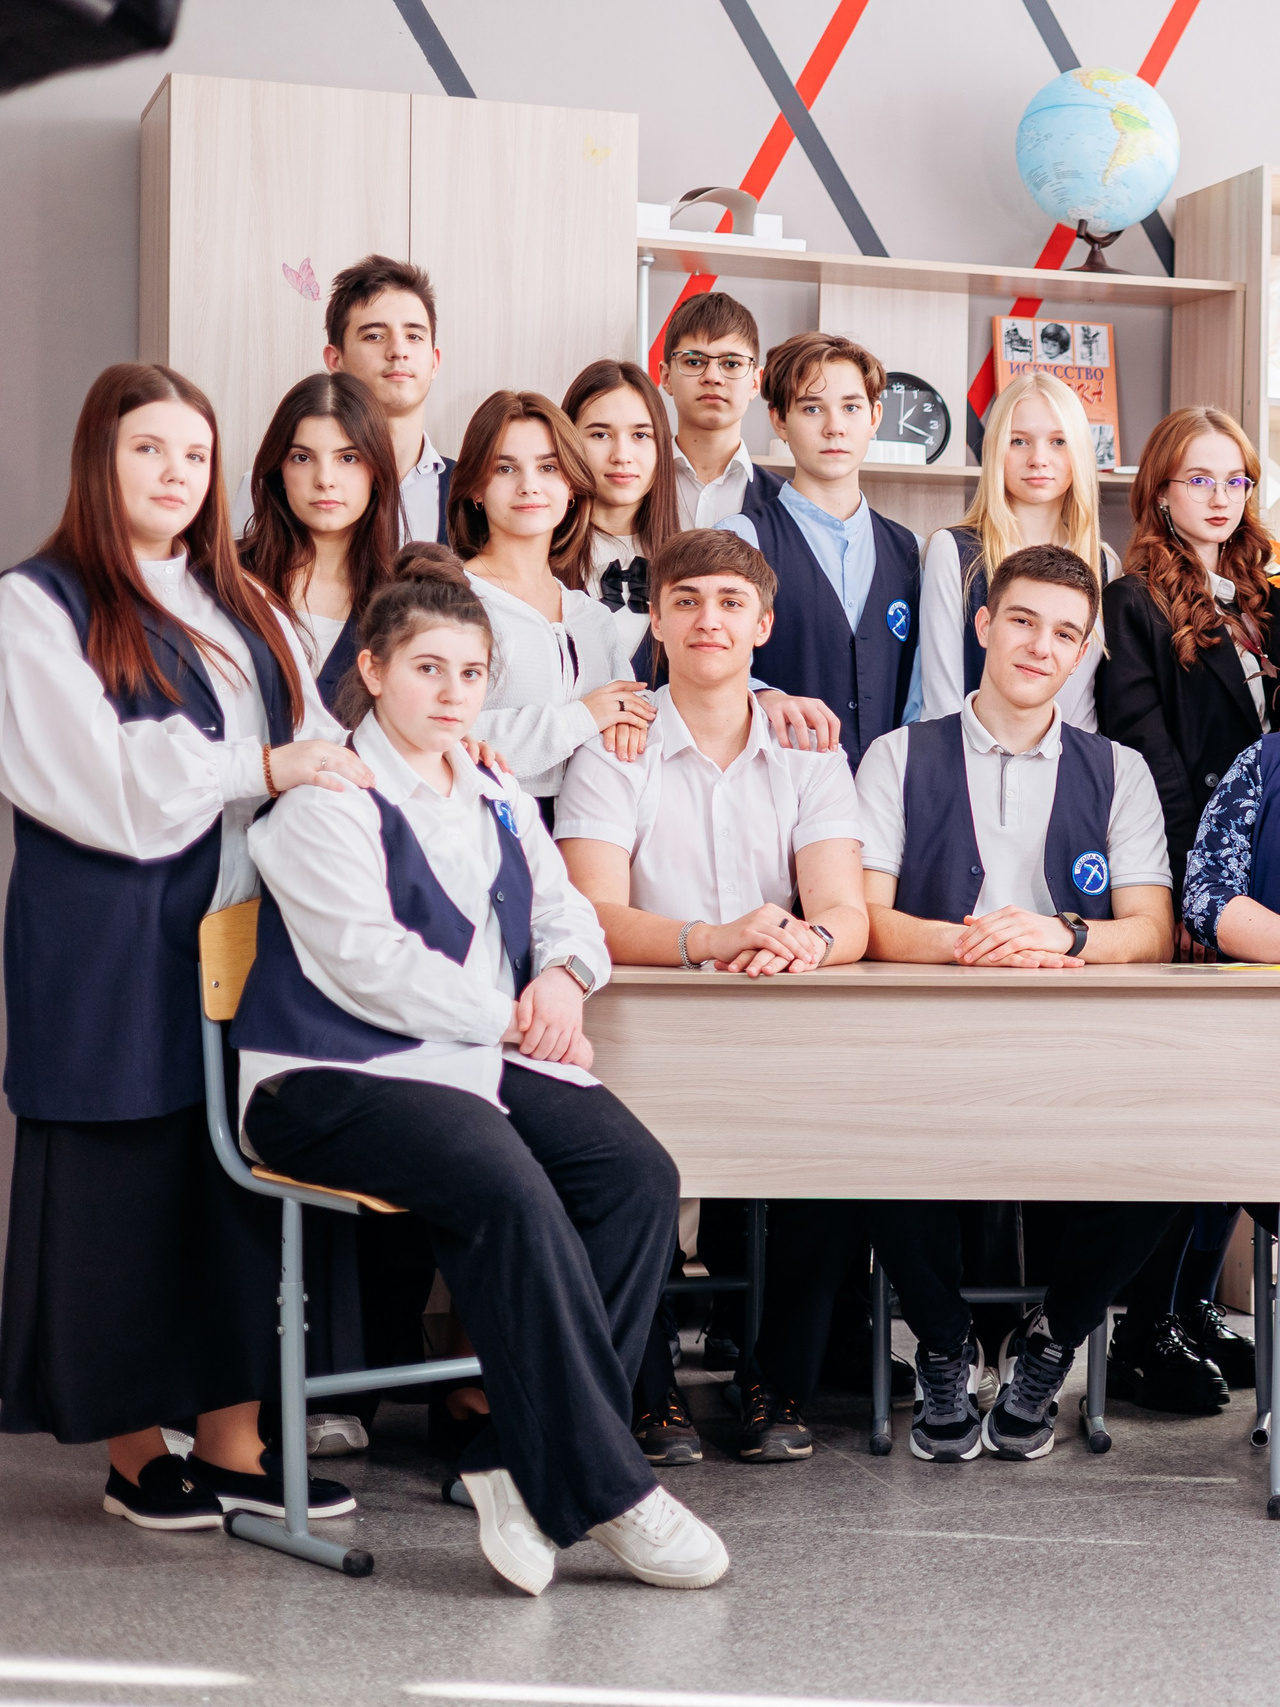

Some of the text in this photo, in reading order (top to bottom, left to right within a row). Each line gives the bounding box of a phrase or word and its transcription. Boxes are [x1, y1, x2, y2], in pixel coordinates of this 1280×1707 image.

[892, 384, 905, 394] 12
[912, 390, 918, 400] 1
[922, 403, 933, 412] 2
[929, 420, 939, 429] 3
[924, 435, 935, 446] 4
[1075, 854, 1094, 870] ШКОЛА
